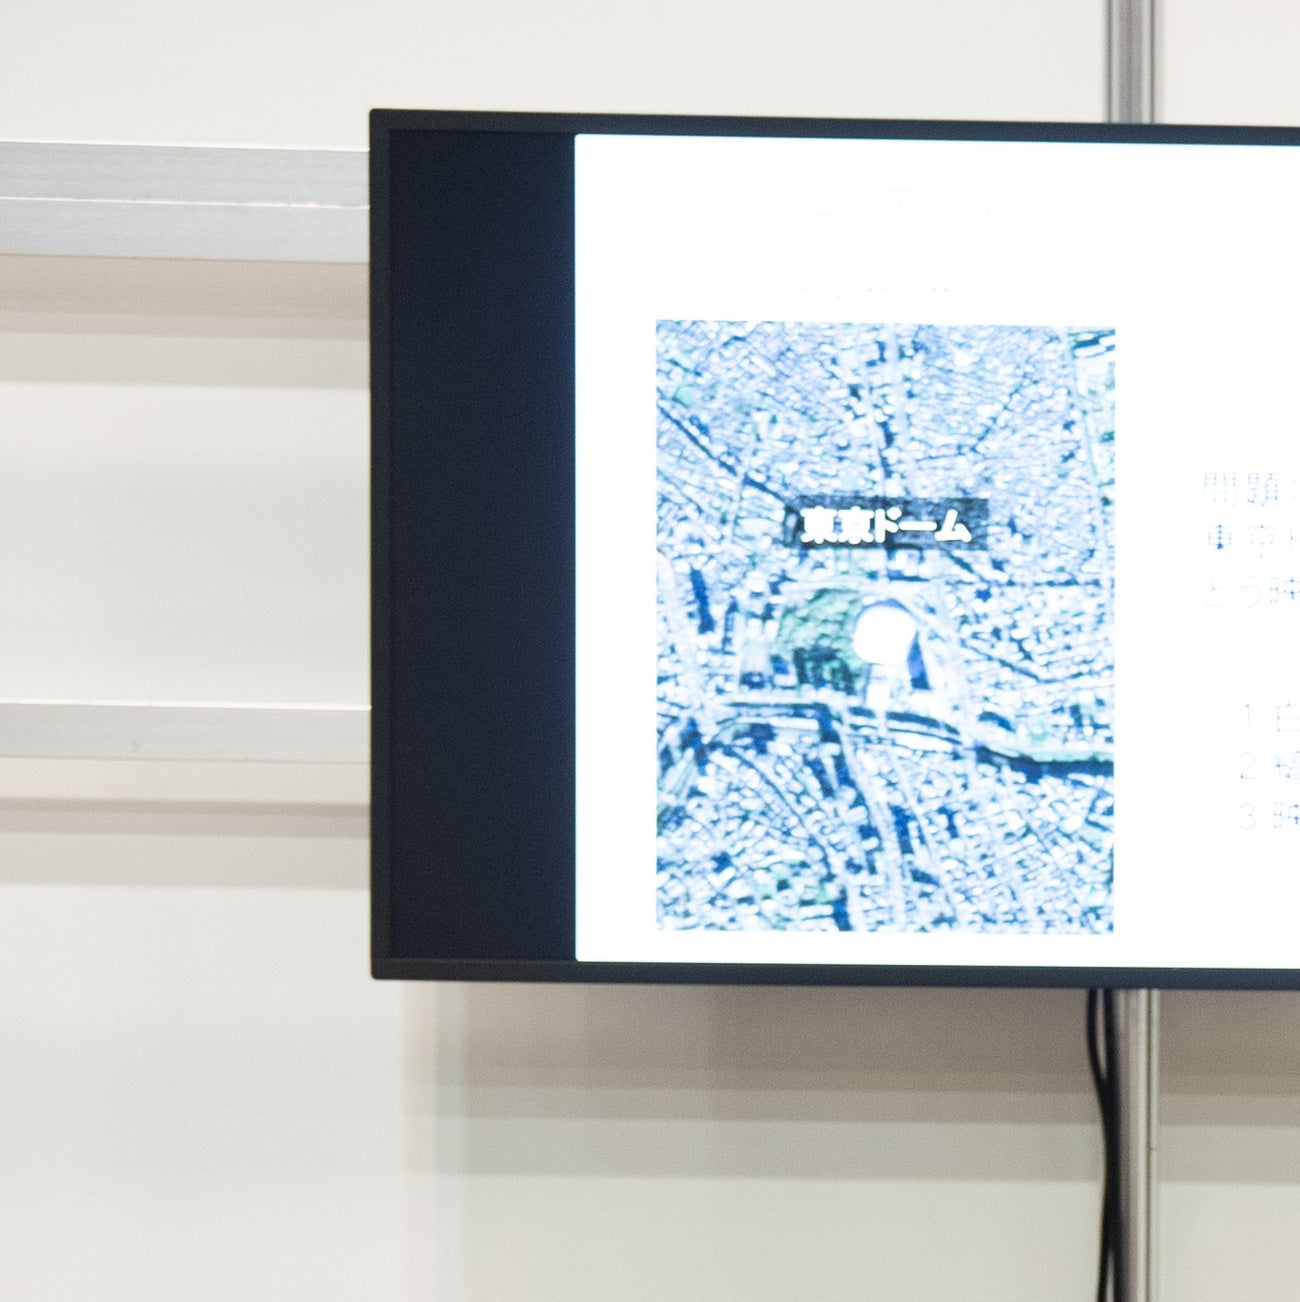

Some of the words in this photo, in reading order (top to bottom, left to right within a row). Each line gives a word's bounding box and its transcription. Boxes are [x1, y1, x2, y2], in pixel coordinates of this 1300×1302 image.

[798, 504, 973, 548] 東京ドーム
